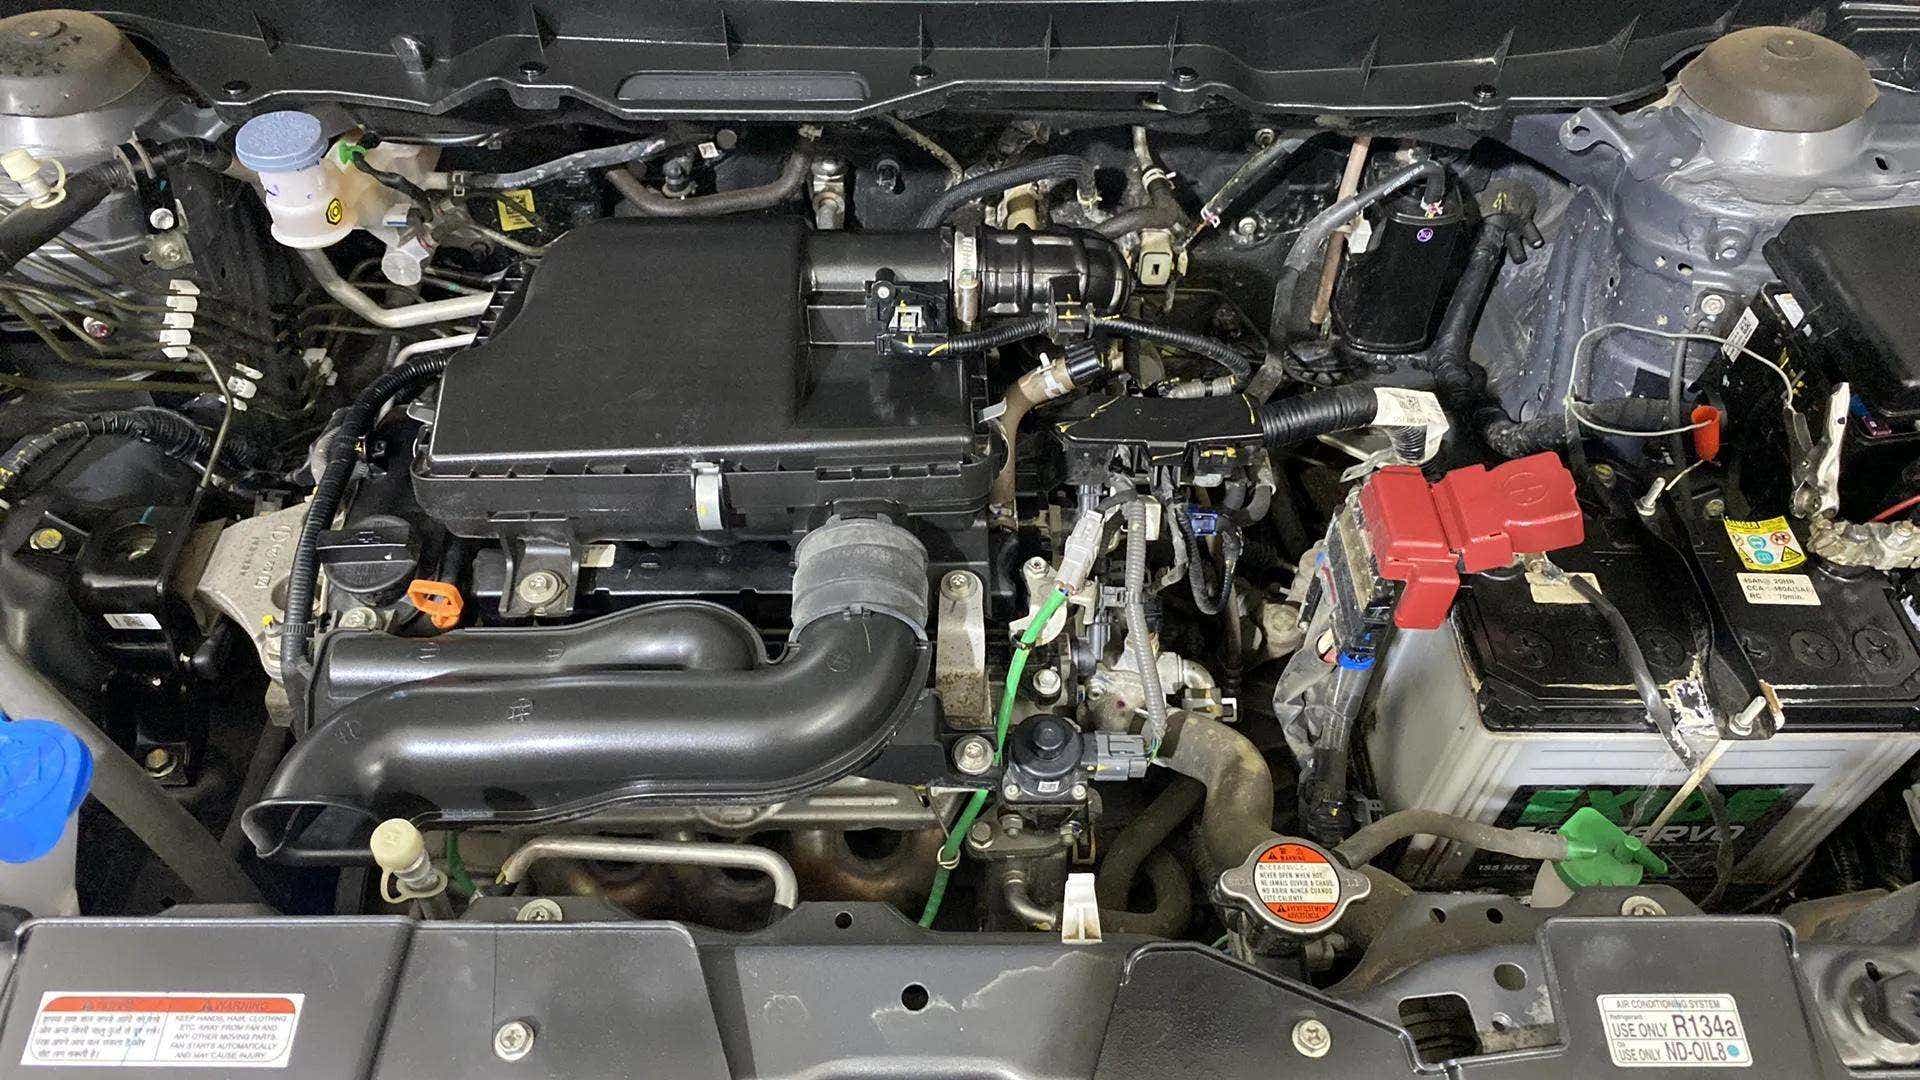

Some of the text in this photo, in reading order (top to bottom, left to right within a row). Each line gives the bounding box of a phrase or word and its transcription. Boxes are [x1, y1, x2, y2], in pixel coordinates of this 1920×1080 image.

[215, 1000, 269, 1011] WARNING
[1616, 999, 1721, 1009] AIR CONDITIONING SYSTEM
[1612, 1014, 1738, 1038] USE ONLY R134a
[192, 1033, 219, 1041] OTHER
[220, 1033, 250, 1041] MOVING
[216, 1042, 278, 1050] AUTOMATICALLY
[1617, 1041, 1728, 1062] USE ONLY ND-OIL8
